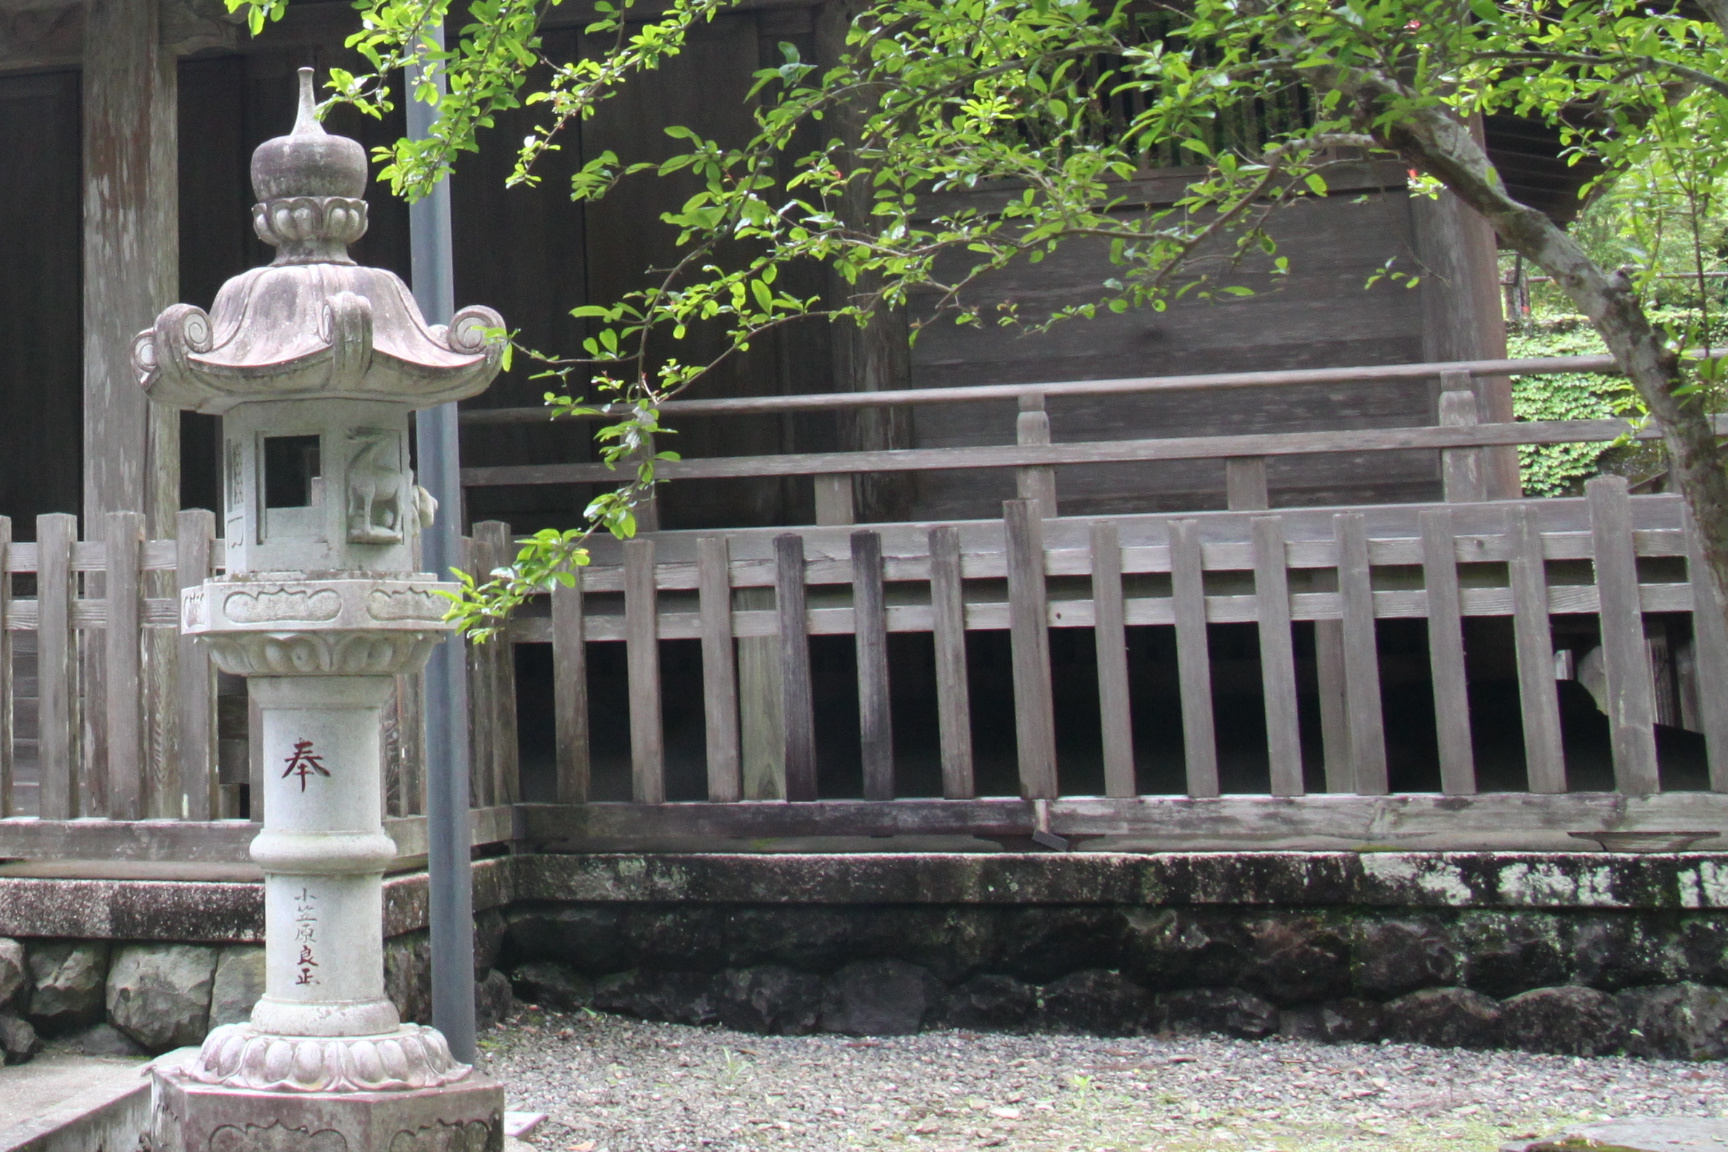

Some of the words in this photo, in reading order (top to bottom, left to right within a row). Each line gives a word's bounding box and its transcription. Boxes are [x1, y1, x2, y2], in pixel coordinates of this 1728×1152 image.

[282, 737, 331, 793] 奉
[294, 887, 321, 985] 小笠原良正
